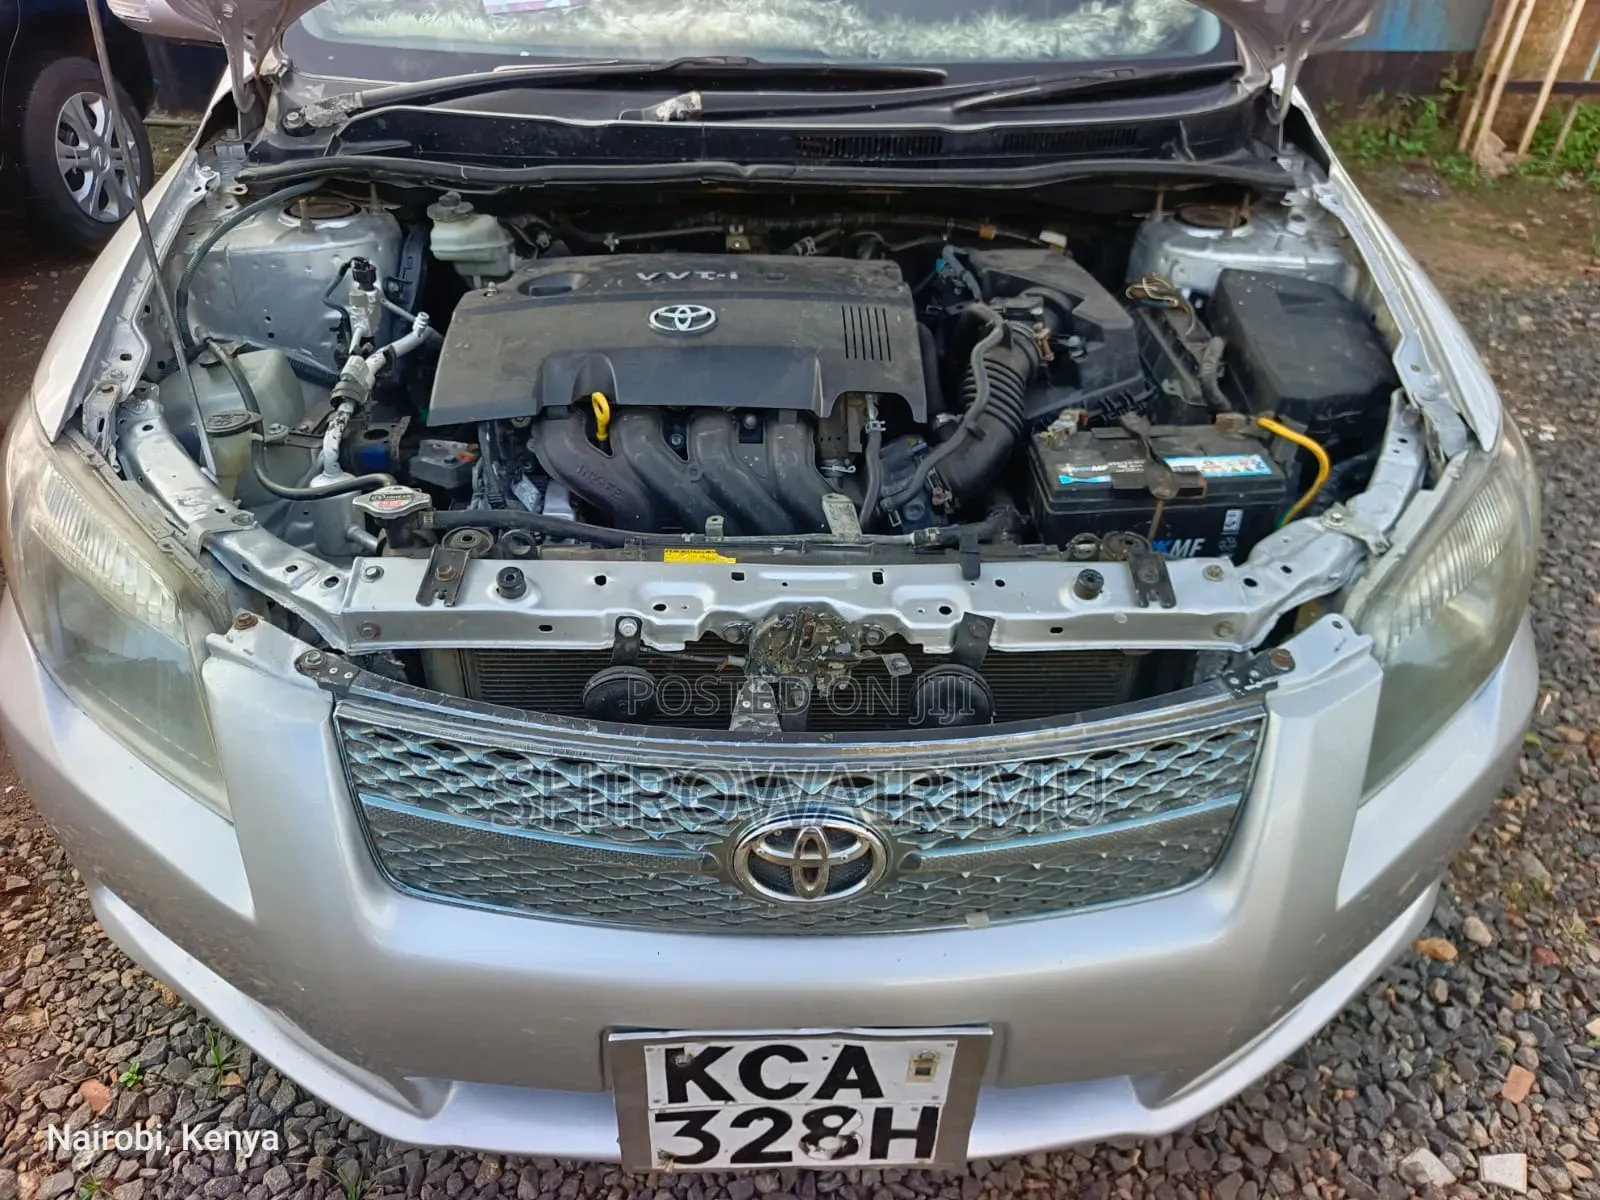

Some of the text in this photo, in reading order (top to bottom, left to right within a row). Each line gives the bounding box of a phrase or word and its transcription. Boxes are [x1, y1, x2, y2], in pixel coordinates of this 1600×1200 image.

[1170, 538, 1206, 558] MF
[663, 1044, 885, 1104] KCA
[654, 1105, 940, 1165] 328H
